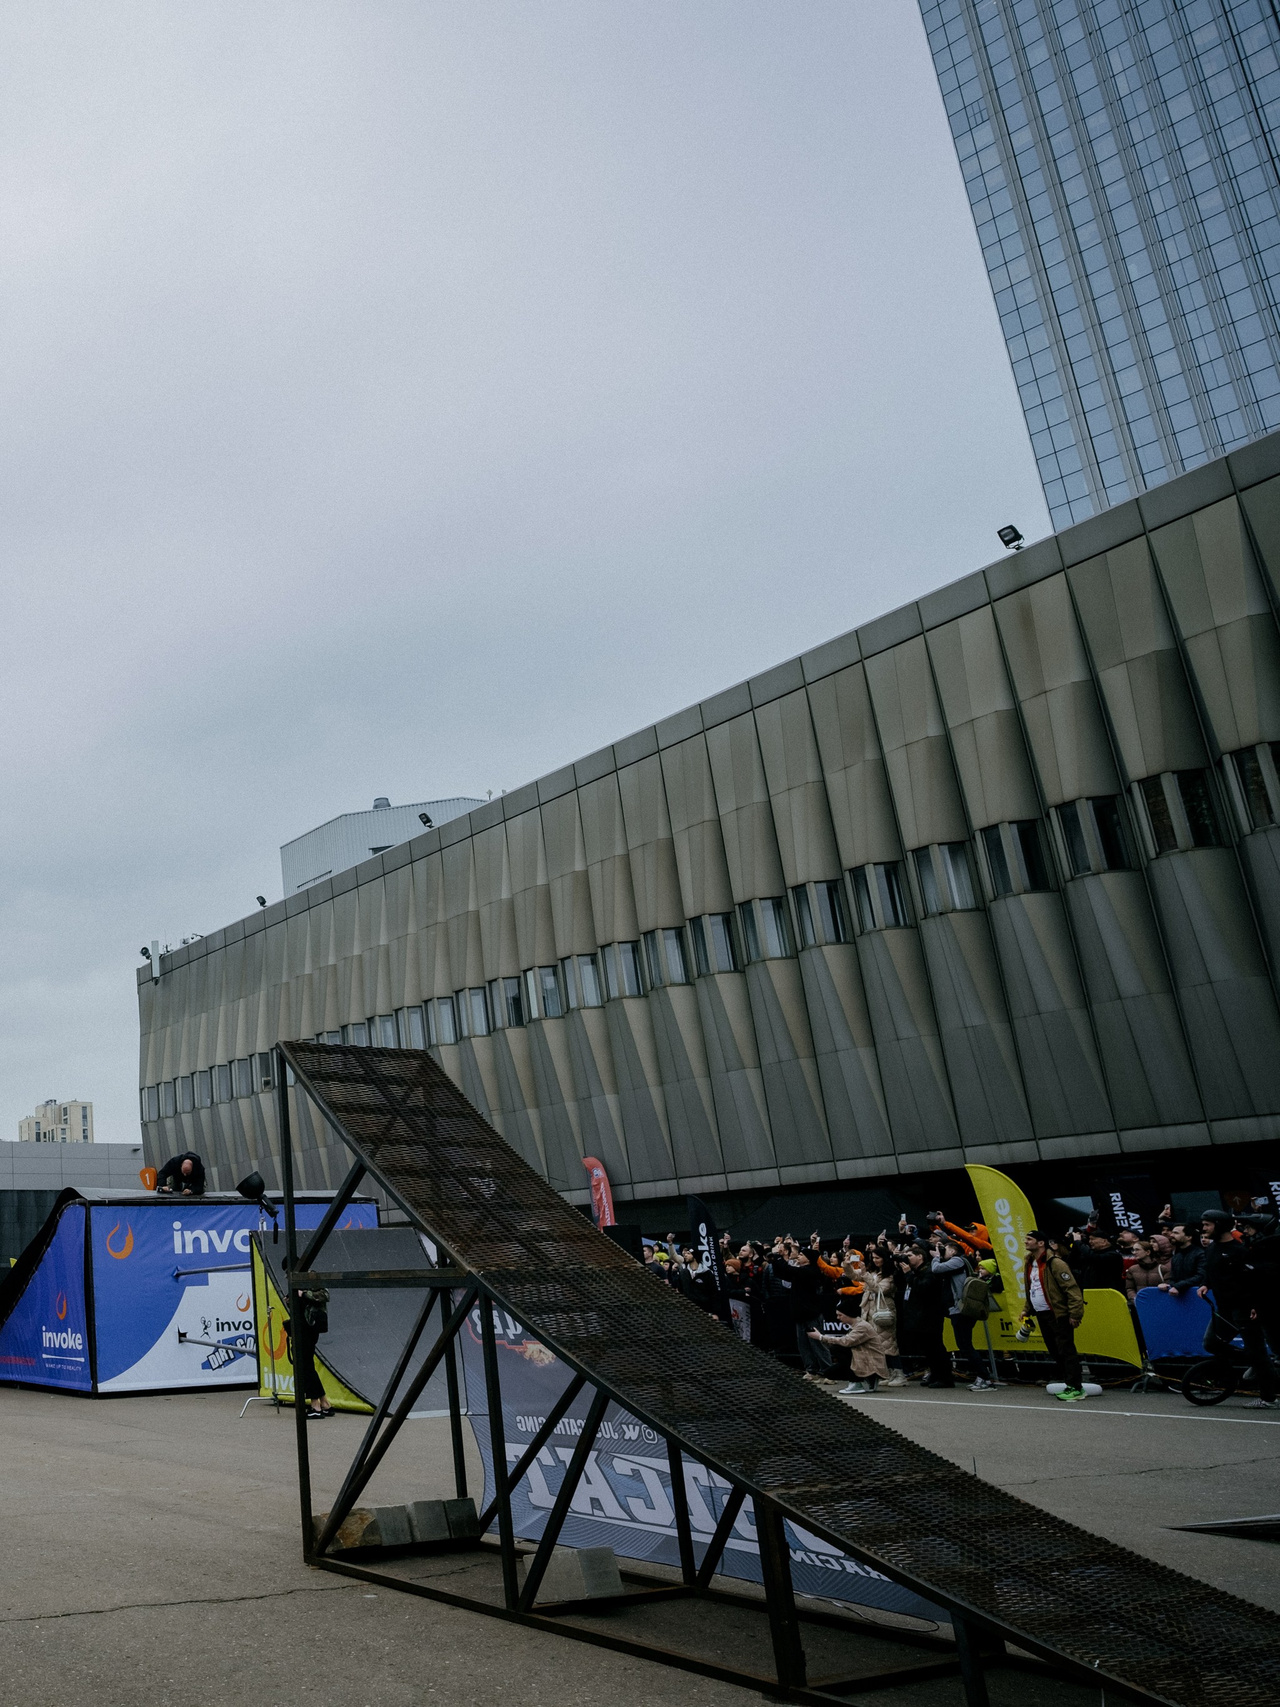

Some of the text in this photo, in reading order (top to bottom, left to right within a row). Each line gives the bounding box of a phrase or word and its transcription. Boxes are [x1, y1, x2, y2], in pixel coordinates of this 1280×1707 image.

[145, 1172, 150, 1186] 1
[173, 1221, 267, 1254] invo
[697, 1222, 712, 1268] oke
[708, 1236, 717, 1260] DRINK
[995, 1198, 1026, 1300] invoke
[42, 1325, 83, 1350] invoke
[216, 1318, 253, 1332] invo
[823, 1319, 852, 1331] invo
[263, 1366, 295, 1392] inv
